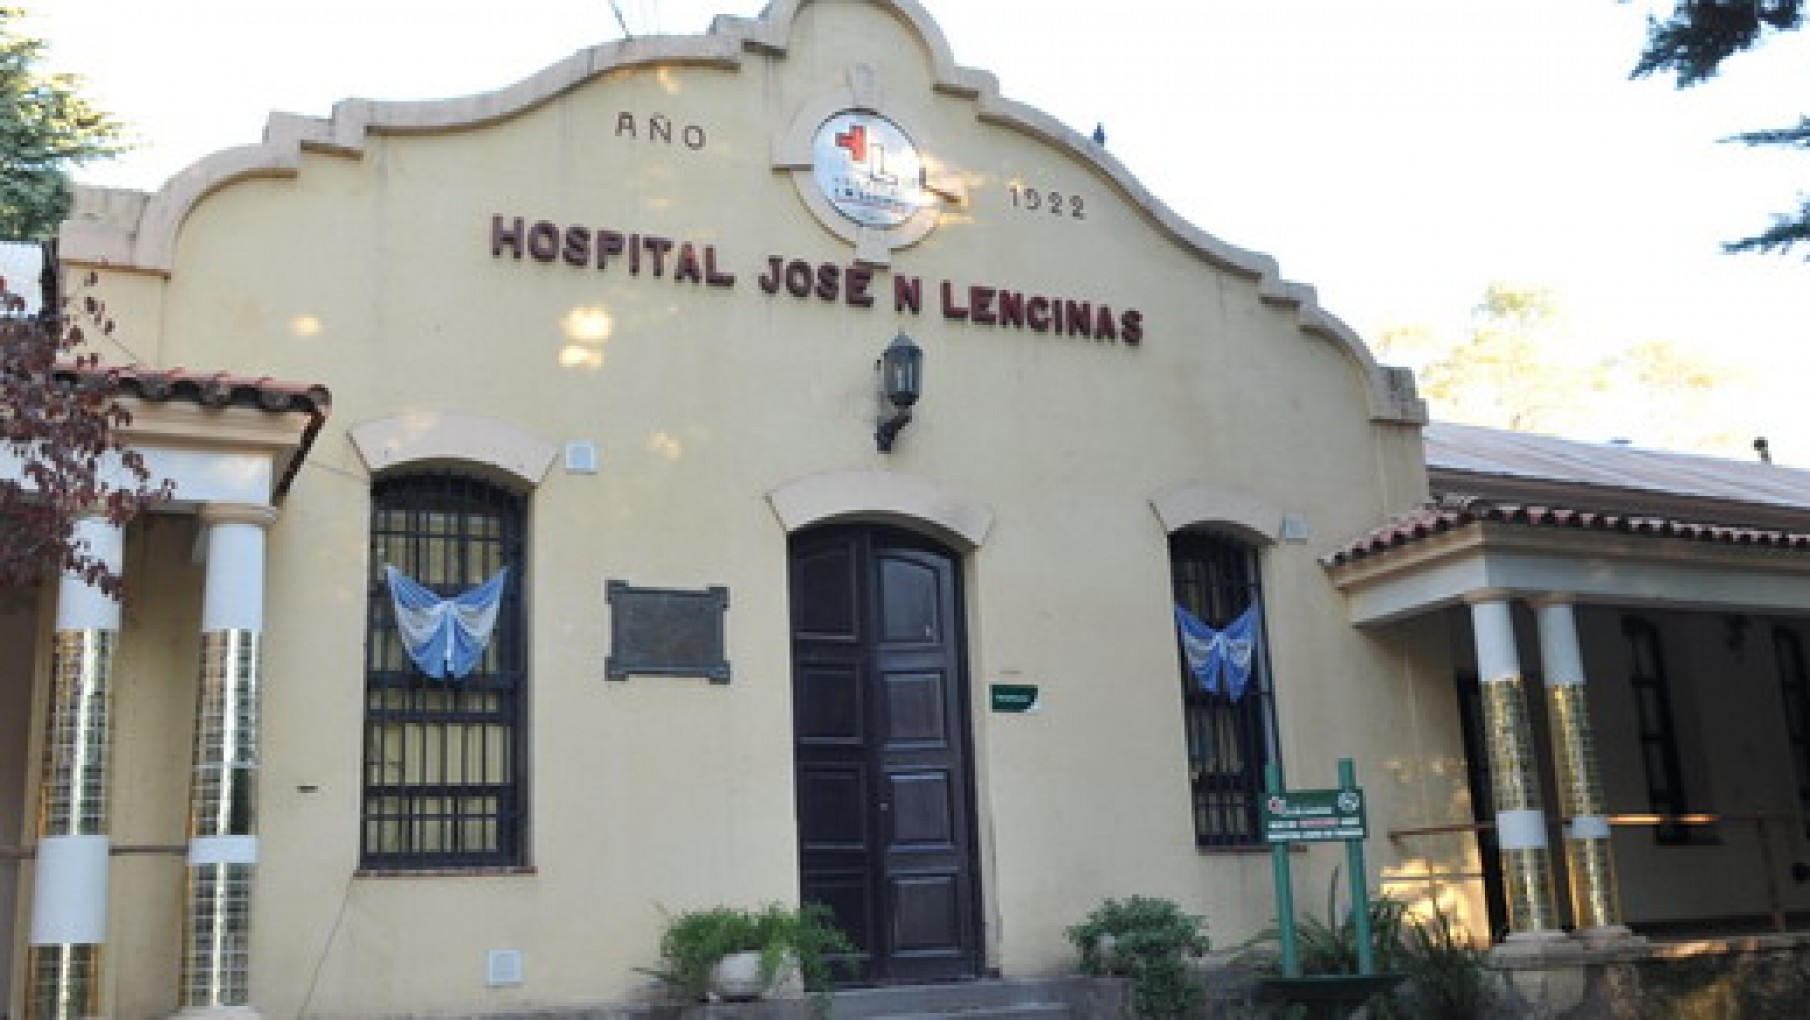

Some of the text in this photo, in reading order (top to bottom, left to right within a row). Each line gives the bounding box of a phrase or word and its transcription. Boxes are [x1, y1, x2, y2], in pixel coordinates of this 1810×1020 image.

[615, 111, 706, 150] AÑO
[1009, 185, 1086, 220] 1922
[491, 213, 1144, 347] HOSPITAL JOSE N LENCINAS
